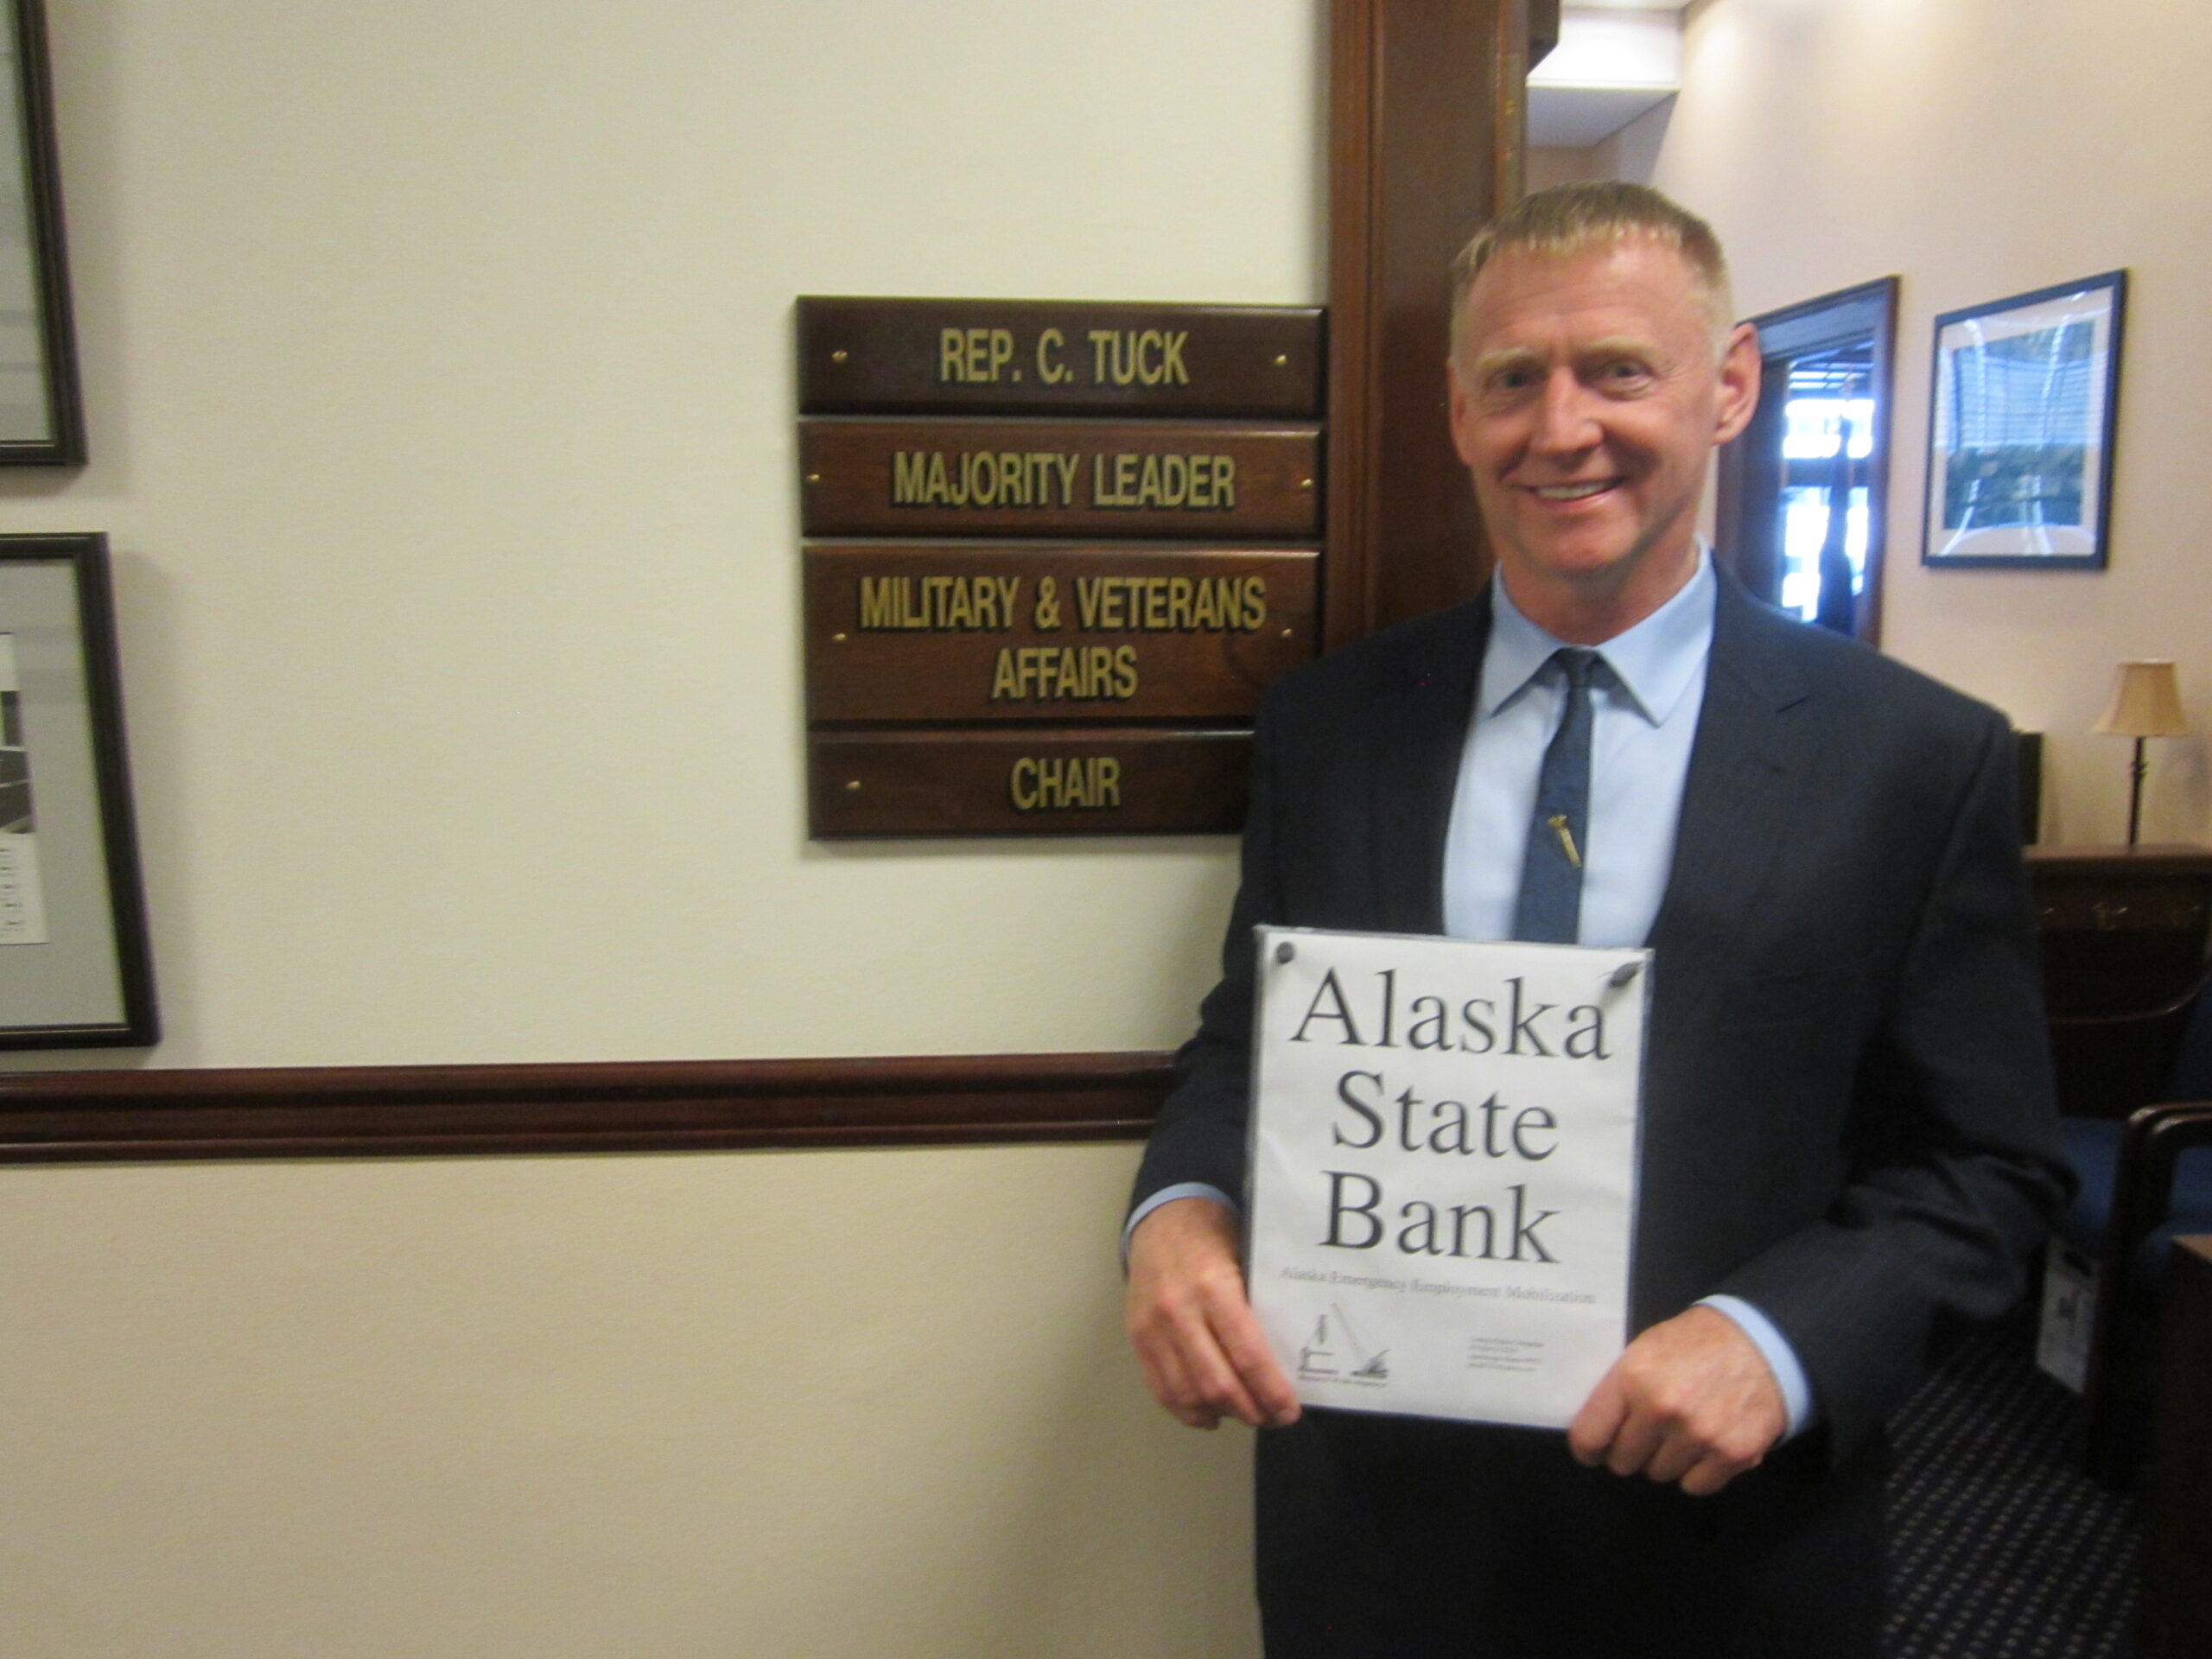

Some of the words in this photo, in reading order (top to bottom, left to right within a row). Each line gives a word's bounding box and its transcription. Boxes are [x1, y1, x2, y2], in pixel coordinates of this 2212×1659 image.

[938, 327, 1022, 383] REP.
[1037, 327, 1074, 385] C.
[1087, 329, 1190, 385] TUCK
[892, 450, 1080, 507] MAJORITY
[1093, 453, 1236, 508] LEADER
[859, 575, 1020, 629] MILITARY
[1035, 575, 1060, 630] &
[1076, 575, 1267, 630] VETERANS
[991, 645, 1139, 699] AFFAIRS
[1010, 757, 1121, 810] CHAIR
[1288, 965, 1613, 1061] Alaska
[1332, 1069, 1560, 1161] State
[1319, 1169, 1561, 1264] Bank
